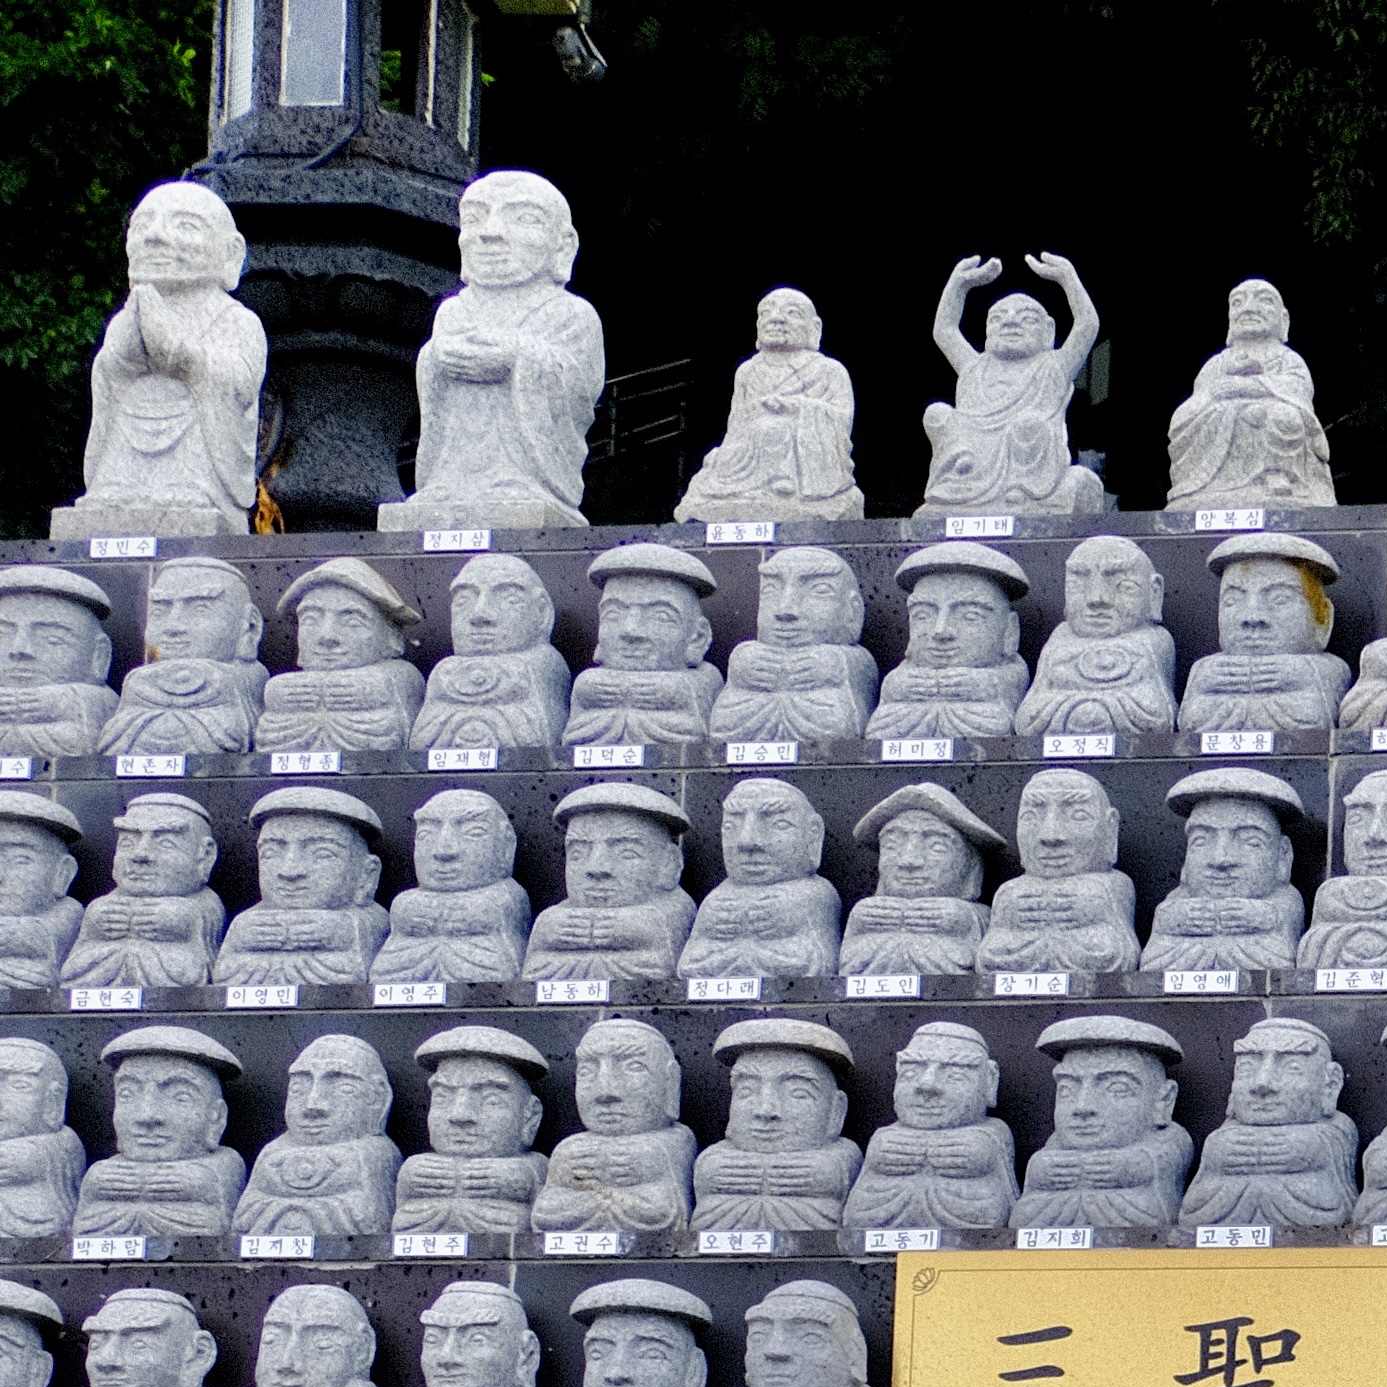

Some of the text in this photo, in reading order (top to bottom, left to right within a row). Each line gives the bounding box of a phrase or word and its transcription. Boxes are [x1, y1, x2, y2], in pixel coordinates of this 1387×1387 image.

[703, 1234, 768, 1251] 오현주
[870, 1232, 935, 1249] 고동기
[1023, 1229, 1087, 1246] 김지희
[1200, 1227, 1267, 1245] 고동민
